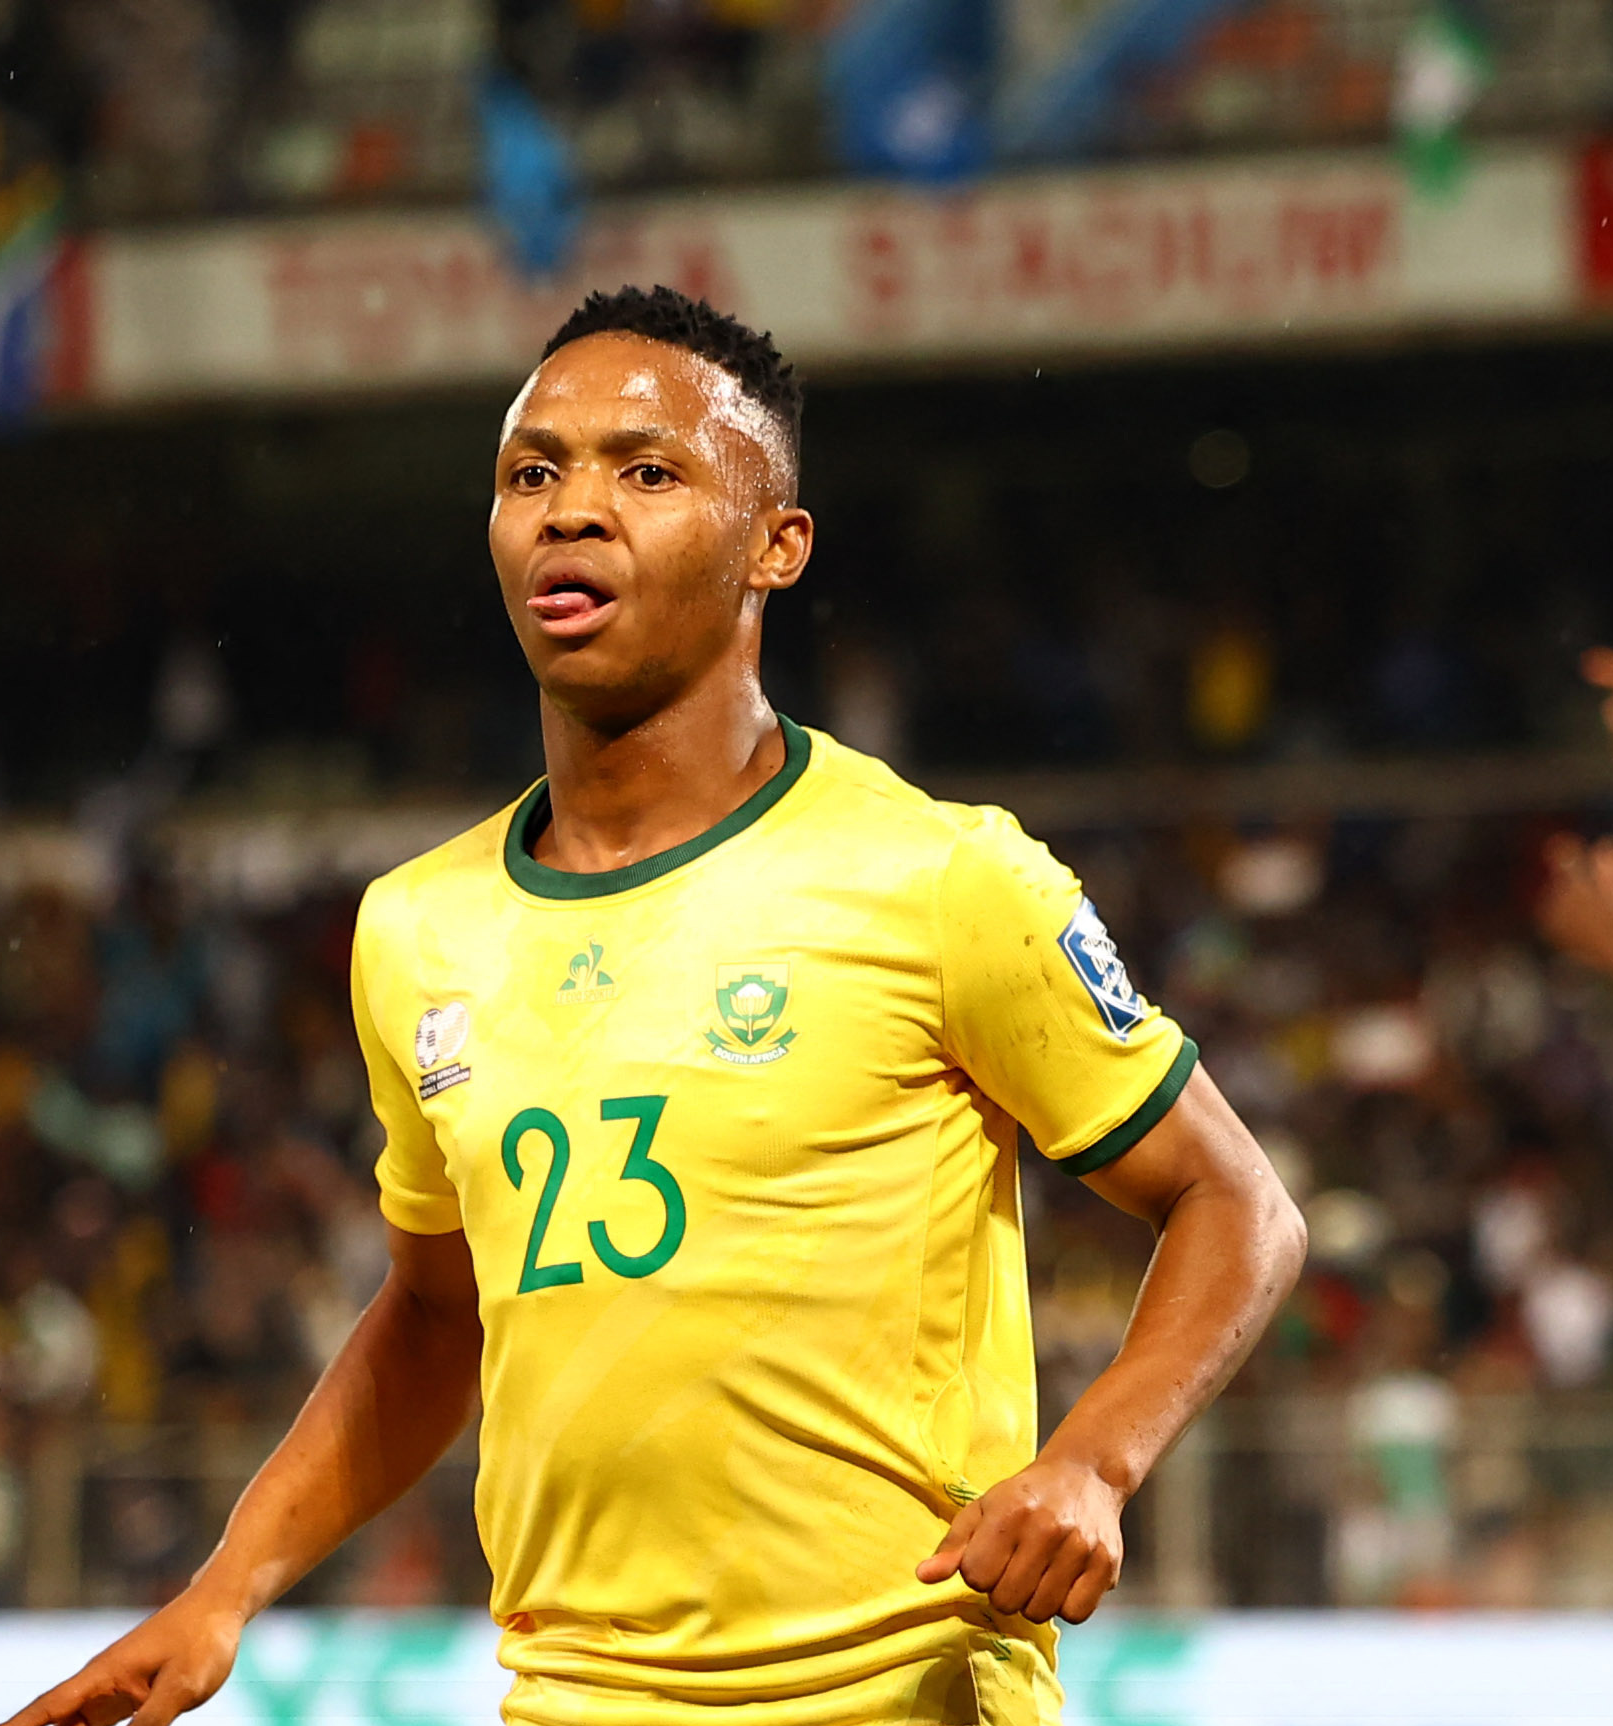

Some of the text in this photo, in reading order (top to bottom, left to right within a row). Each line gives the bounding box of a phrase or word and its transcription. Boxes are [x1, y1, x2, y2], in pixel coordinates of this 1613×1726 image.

[714, 1046, 787, 1064] SOUTH AFRICA
[501, 1095, 686, 1294] 23
